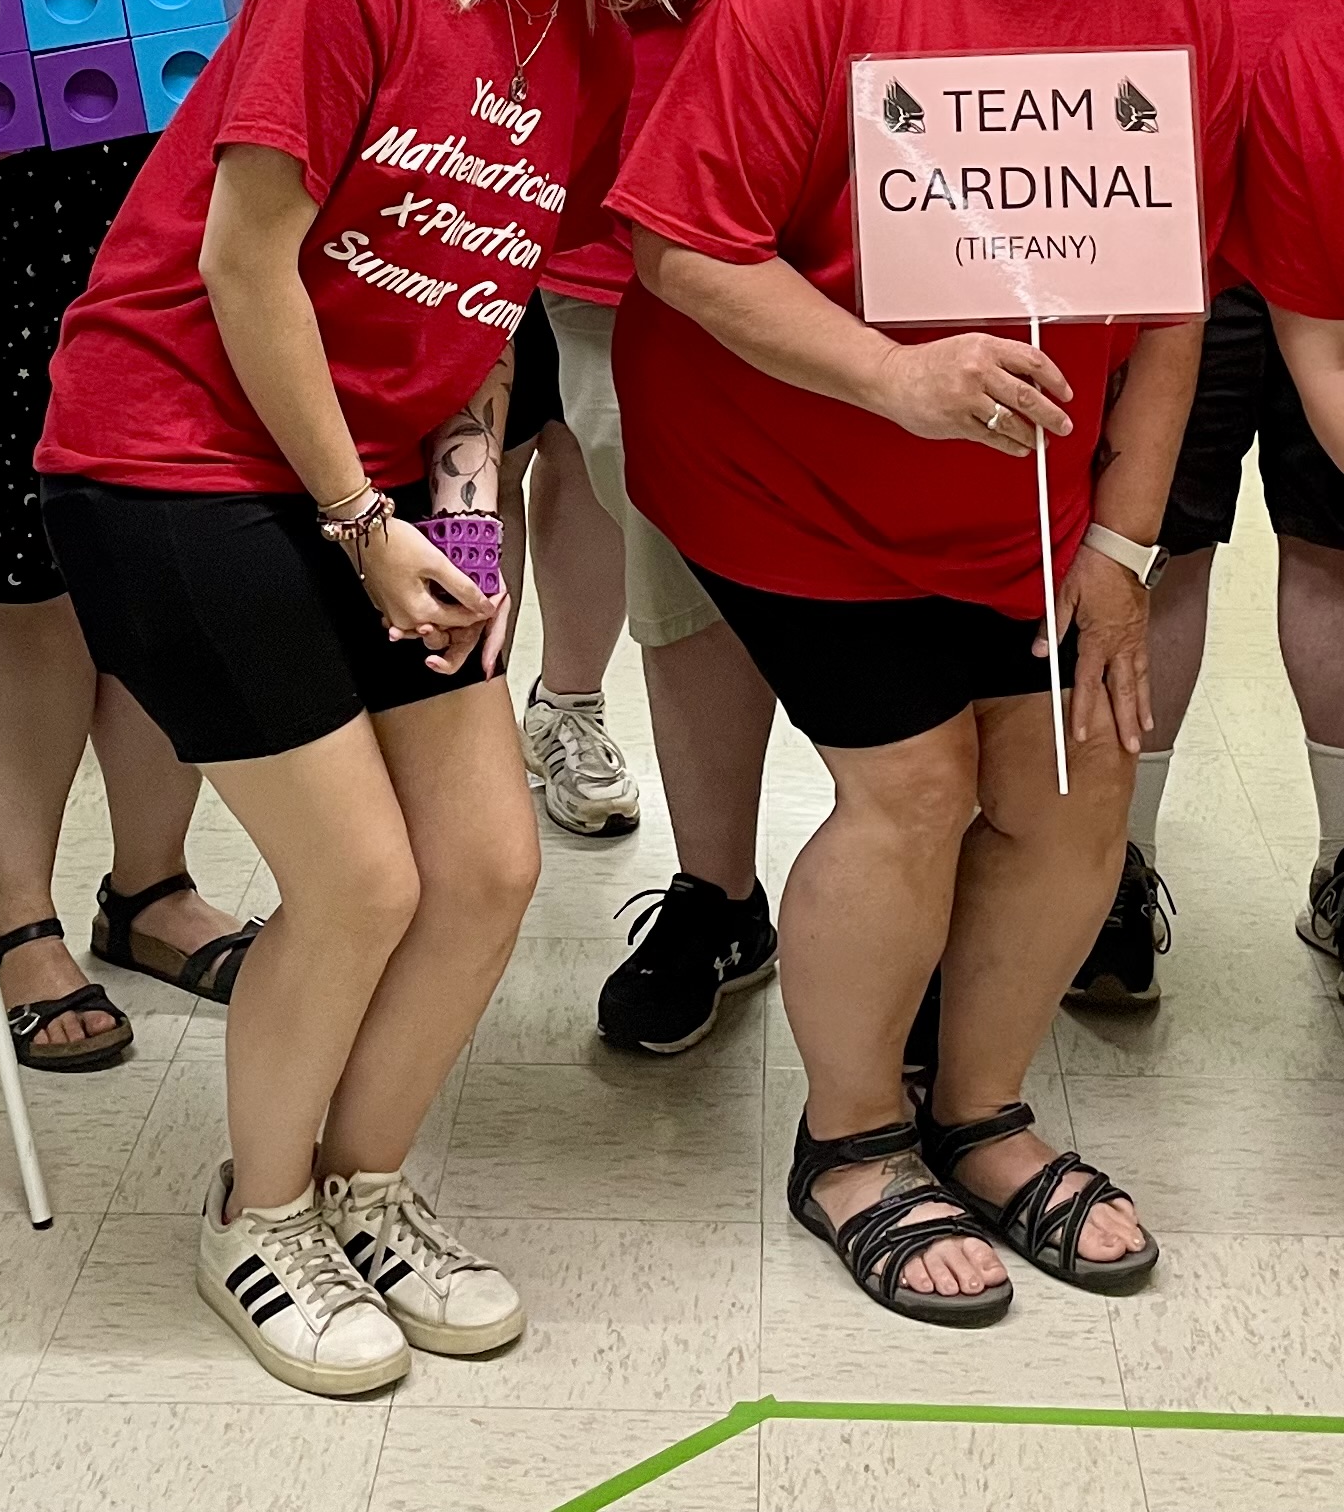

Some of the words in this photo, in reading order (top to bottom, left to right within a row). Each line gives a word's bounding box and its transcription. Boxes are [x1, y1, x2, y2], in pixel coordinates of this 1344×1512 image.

[470, 76, 542, 145] Young
[943, 89, 1093, 132] TEAM
[879, 165, 1173, 212] CARDINAL
[323, 230, 458, 307] Summer
[955, 235, 1097, 266] (TIFFANY)
